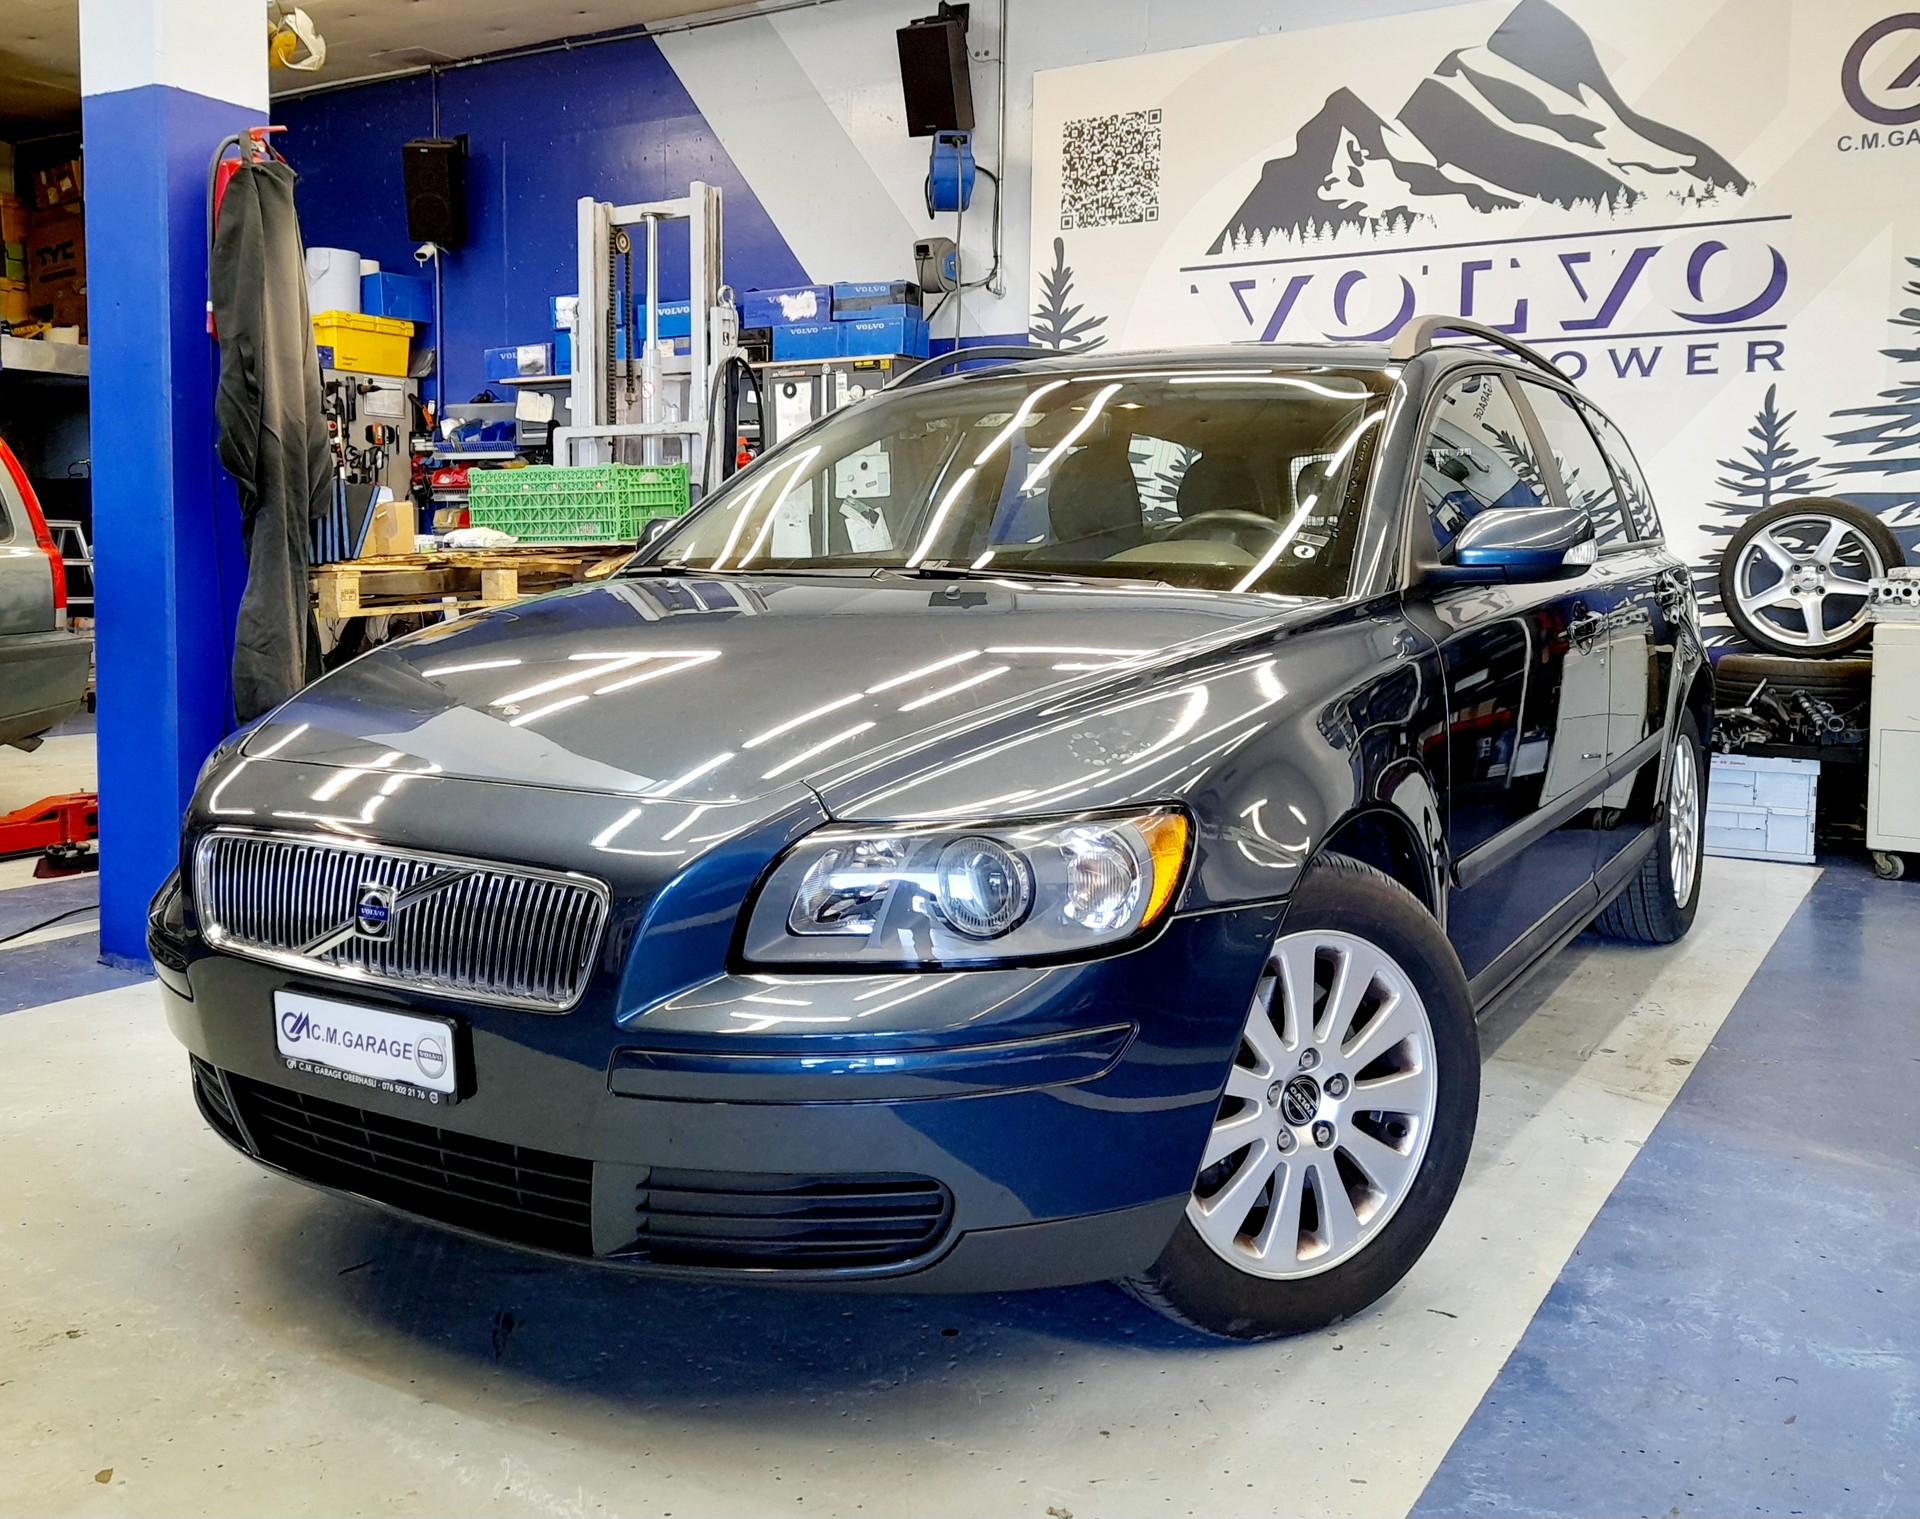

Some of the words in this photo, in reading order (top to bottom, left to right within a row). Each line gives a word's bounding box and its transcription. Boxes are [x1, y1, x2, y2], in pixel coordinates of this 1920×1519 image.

[37, 241, 75, 265] TYC
[855, 285, 887, 293] VOLVO
[1190, 236, 1788, 342] VOLVO
[658, 305, 690, 316] VOLVO
[790, 327, 819, 335] VOLVO
[855, 323, 885, 331] VOLVO
[1495, 340, 1786, 379] OWER
[361, 908, 385, 917] VOLVO
[311, 1023, 413, 1060] C.M.GARAGE
[419, 1050, 443, 1061] VOLVO
[314, 1065, 342, 1080] GARAGE
[382, 1081, 394, 1092] 076
[395, 1084, 407, 1095] 502
[407, 1087, 416, 1097] 21
[417, 1089, 425, 1100] 76
[1290, 1087, 1313, 1118] VOLVO
